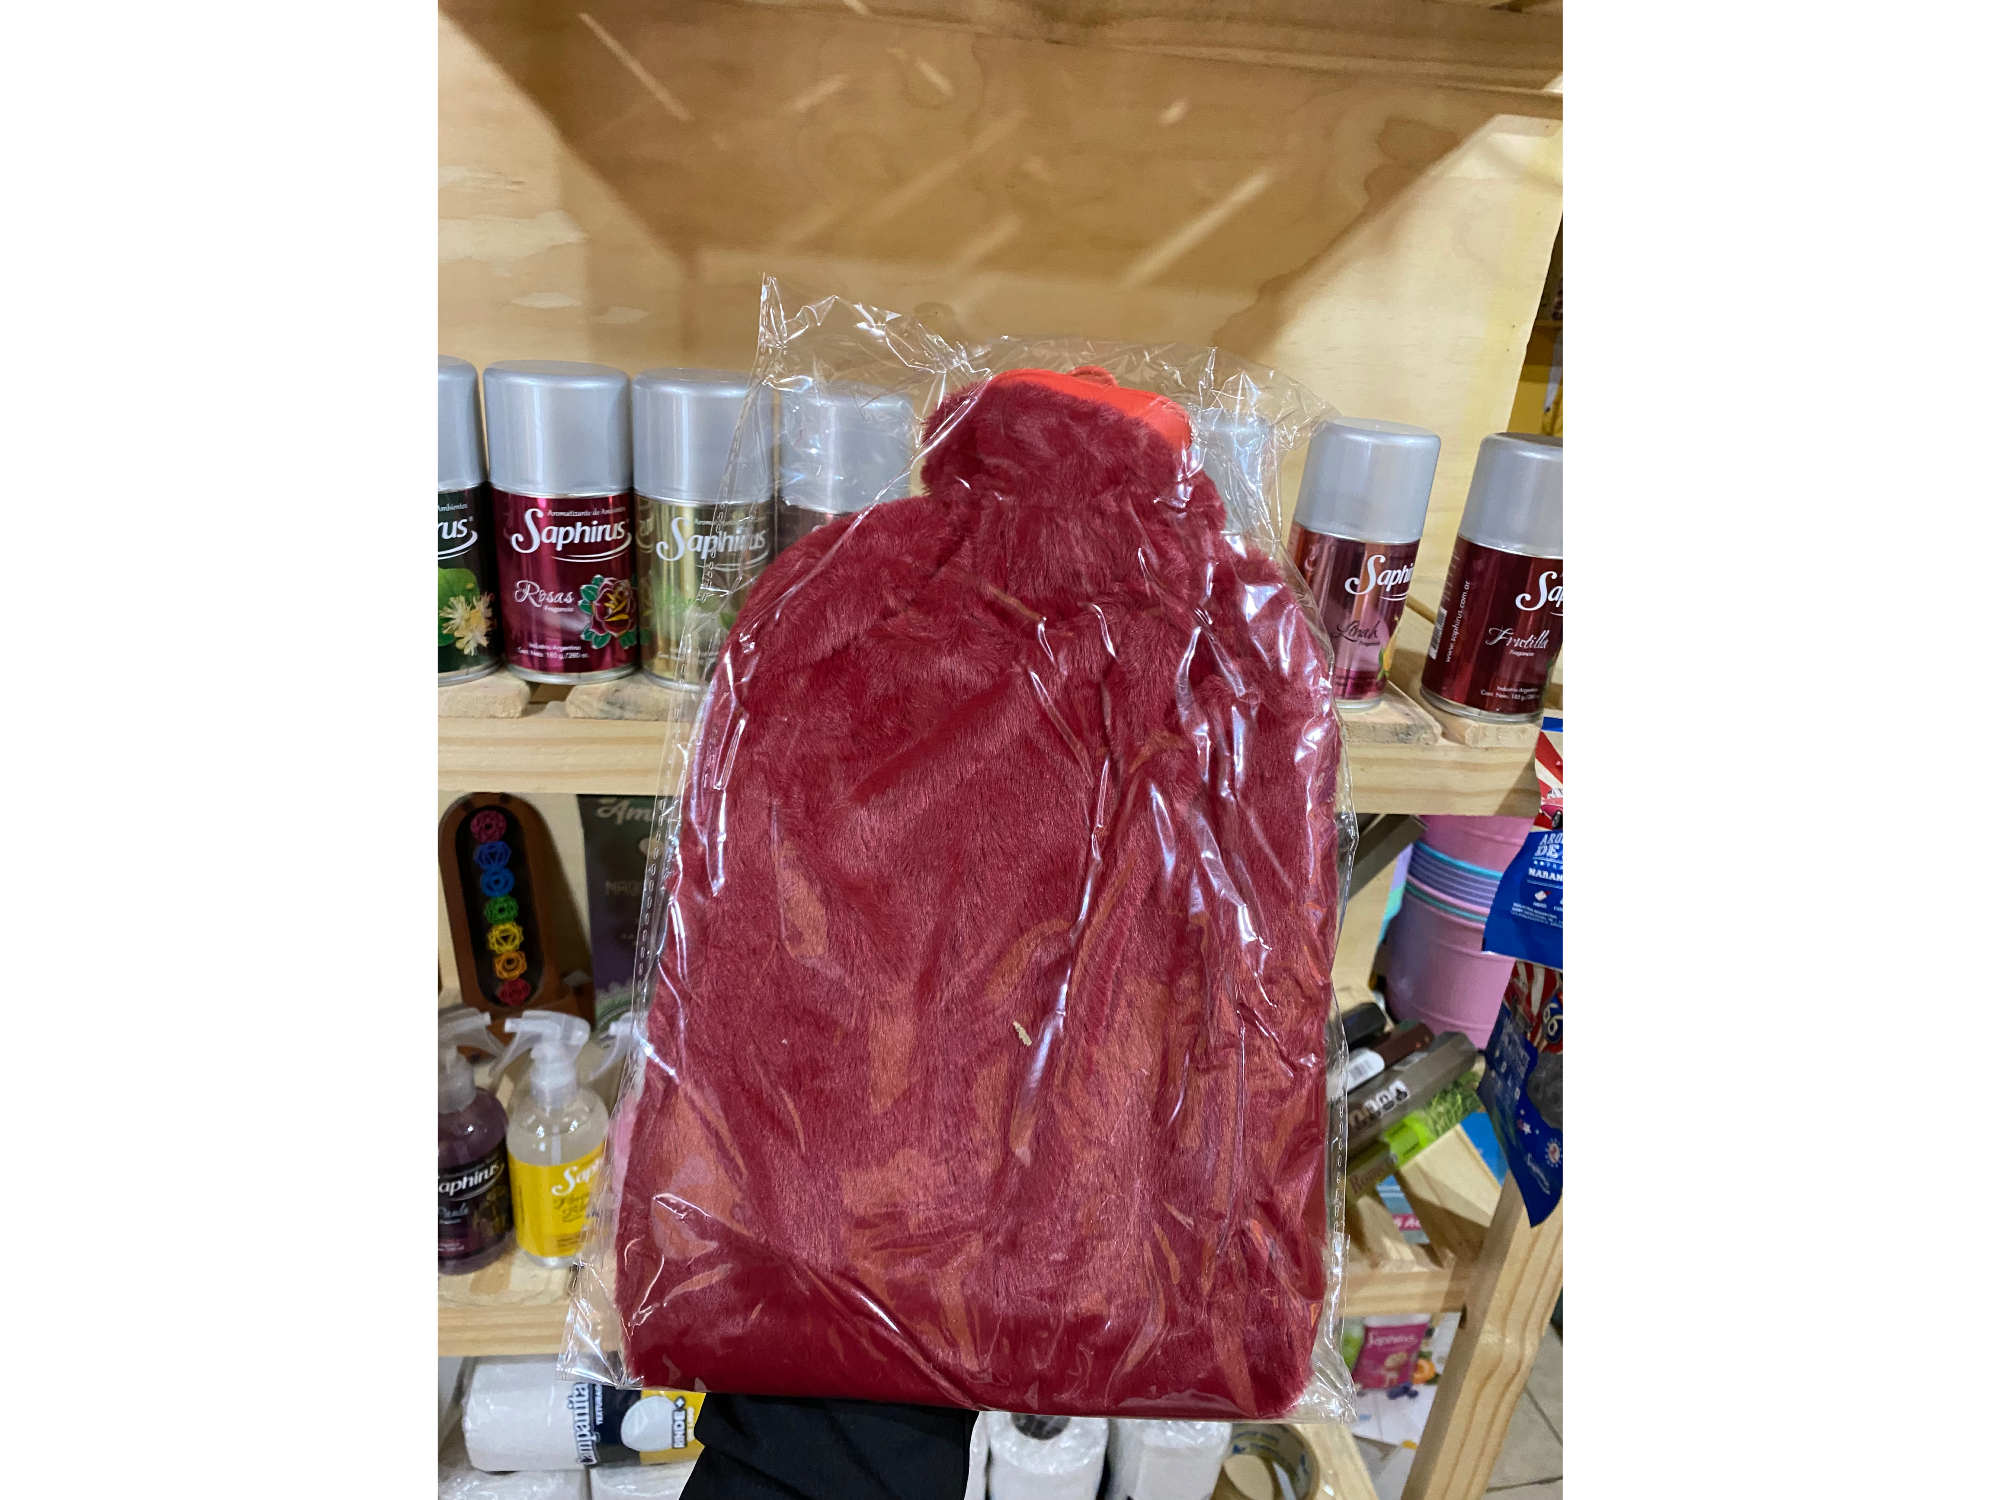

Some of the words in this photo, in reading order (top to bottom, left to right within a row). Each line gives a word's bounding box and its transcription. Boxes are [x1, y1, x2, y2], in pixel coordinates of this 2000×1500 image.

[511, 508, 626, 554] Saphirus
[514, 580, 575, 608] Rosas
[1445, 580, 1471, 663] www.saphirus.com.ar
[672, 1409, 687, 1449] RINDE
